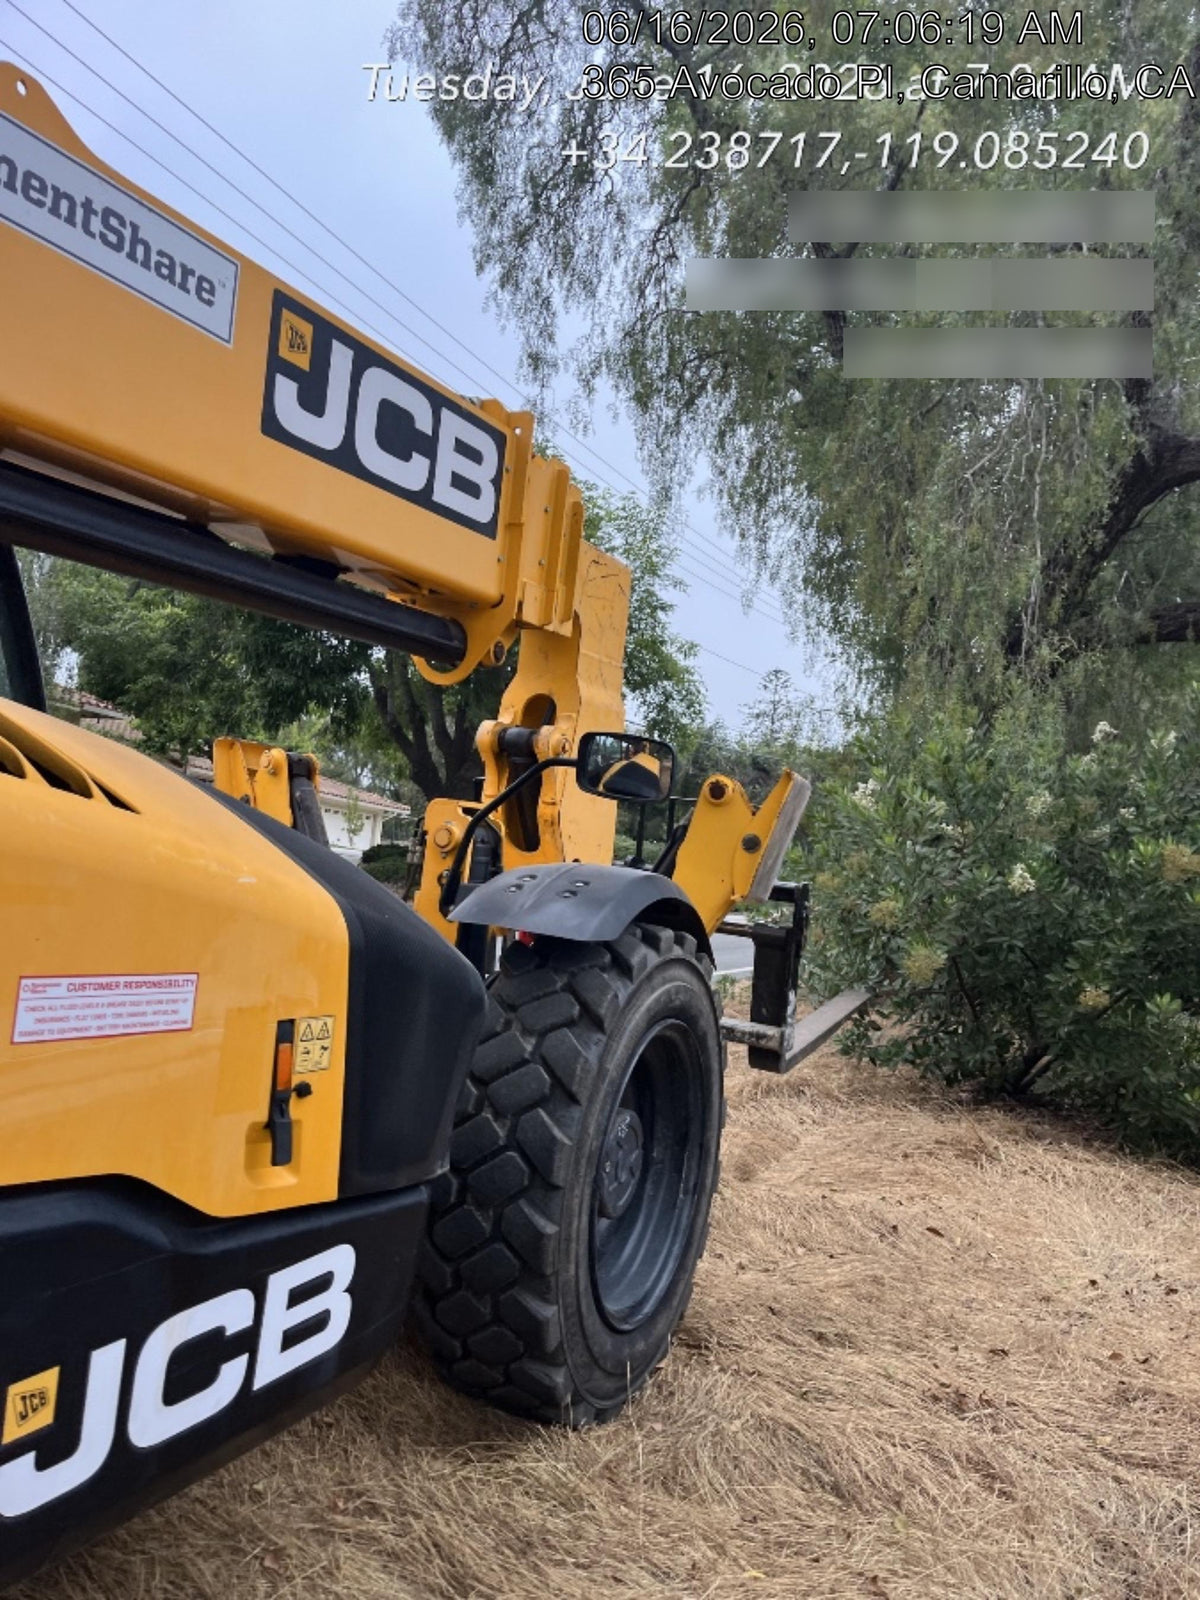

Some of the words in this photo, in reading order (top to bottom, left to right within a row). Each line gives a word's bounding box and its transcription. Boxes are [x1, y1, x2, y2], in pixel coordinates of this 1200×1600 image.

[274, 338, 499, 524] JCB
[67, 981, 122, 993] CUSTOMER
[123, 978, 194, 990] RESPONSIBILITY
[0, 1243, 356, 1517] JCB
[19, 1391, 47, 1421] JCB
